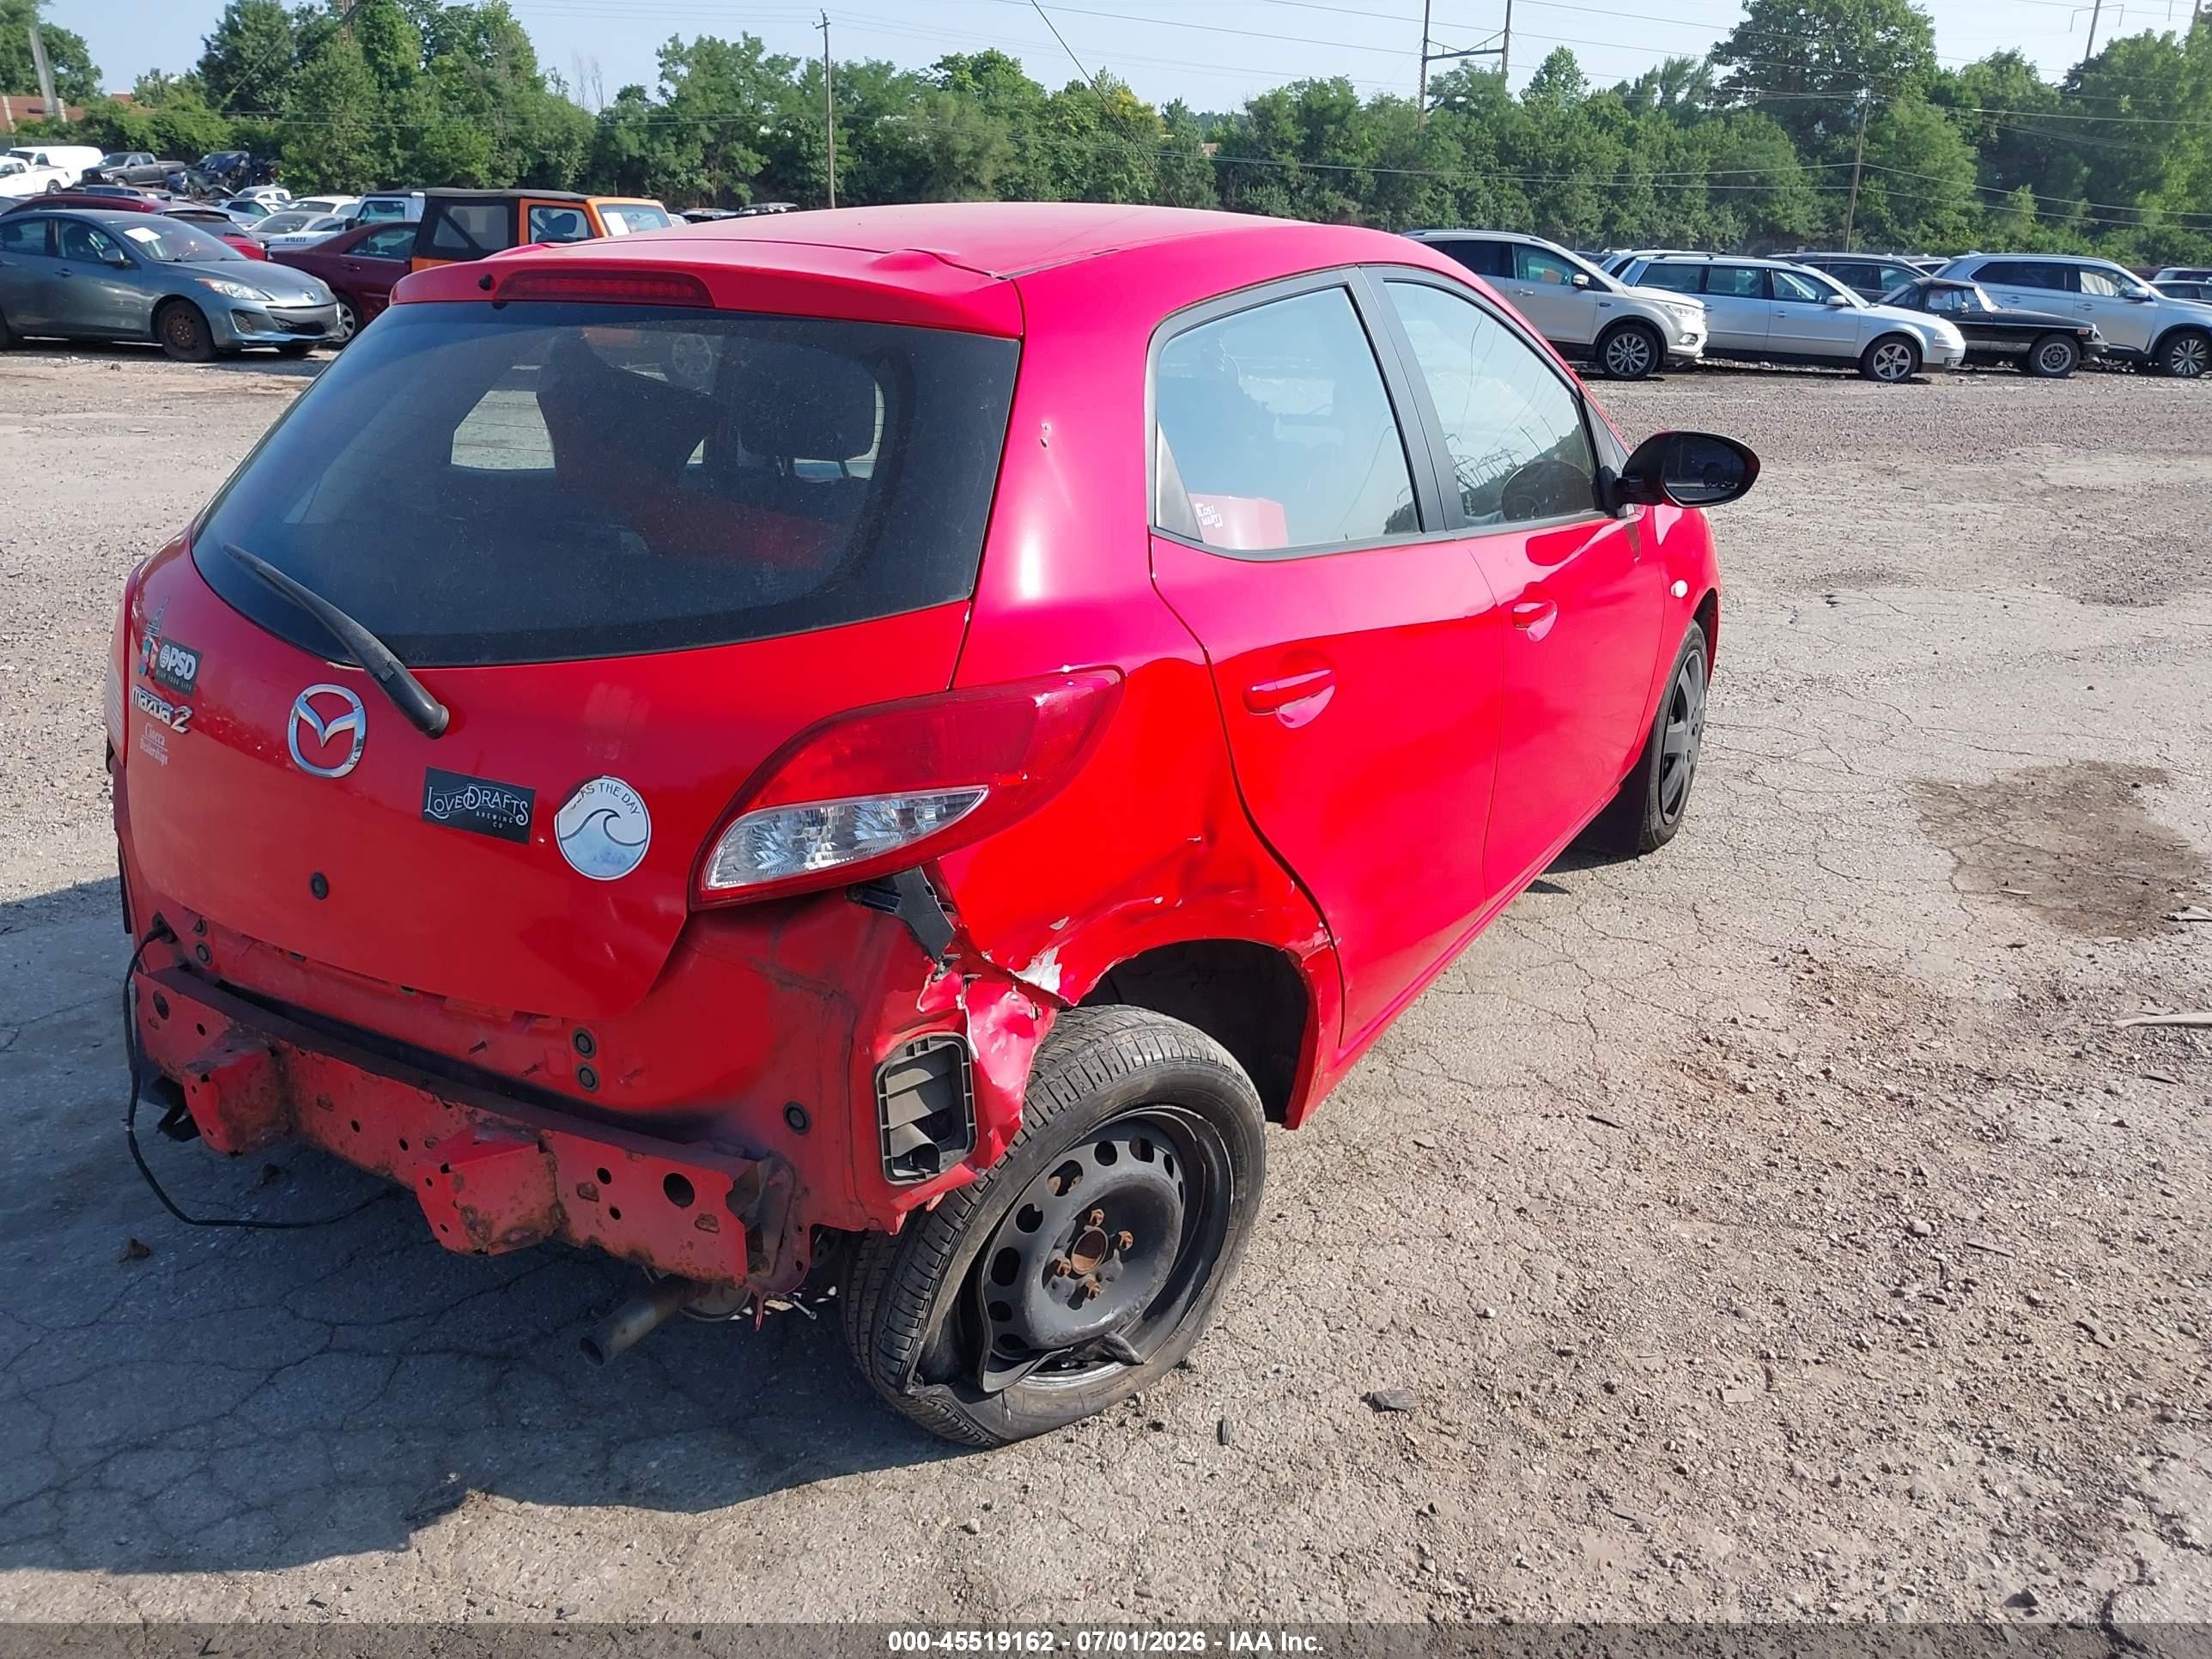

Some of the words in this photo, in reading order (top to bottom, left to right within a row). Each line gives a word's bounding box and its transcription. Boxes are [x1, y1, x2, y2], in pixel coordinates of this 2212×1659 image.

[167, 647, 196, 680] PSD
[599, 782, 622, 798] THE
[621, 793, 641, 816] DAY
